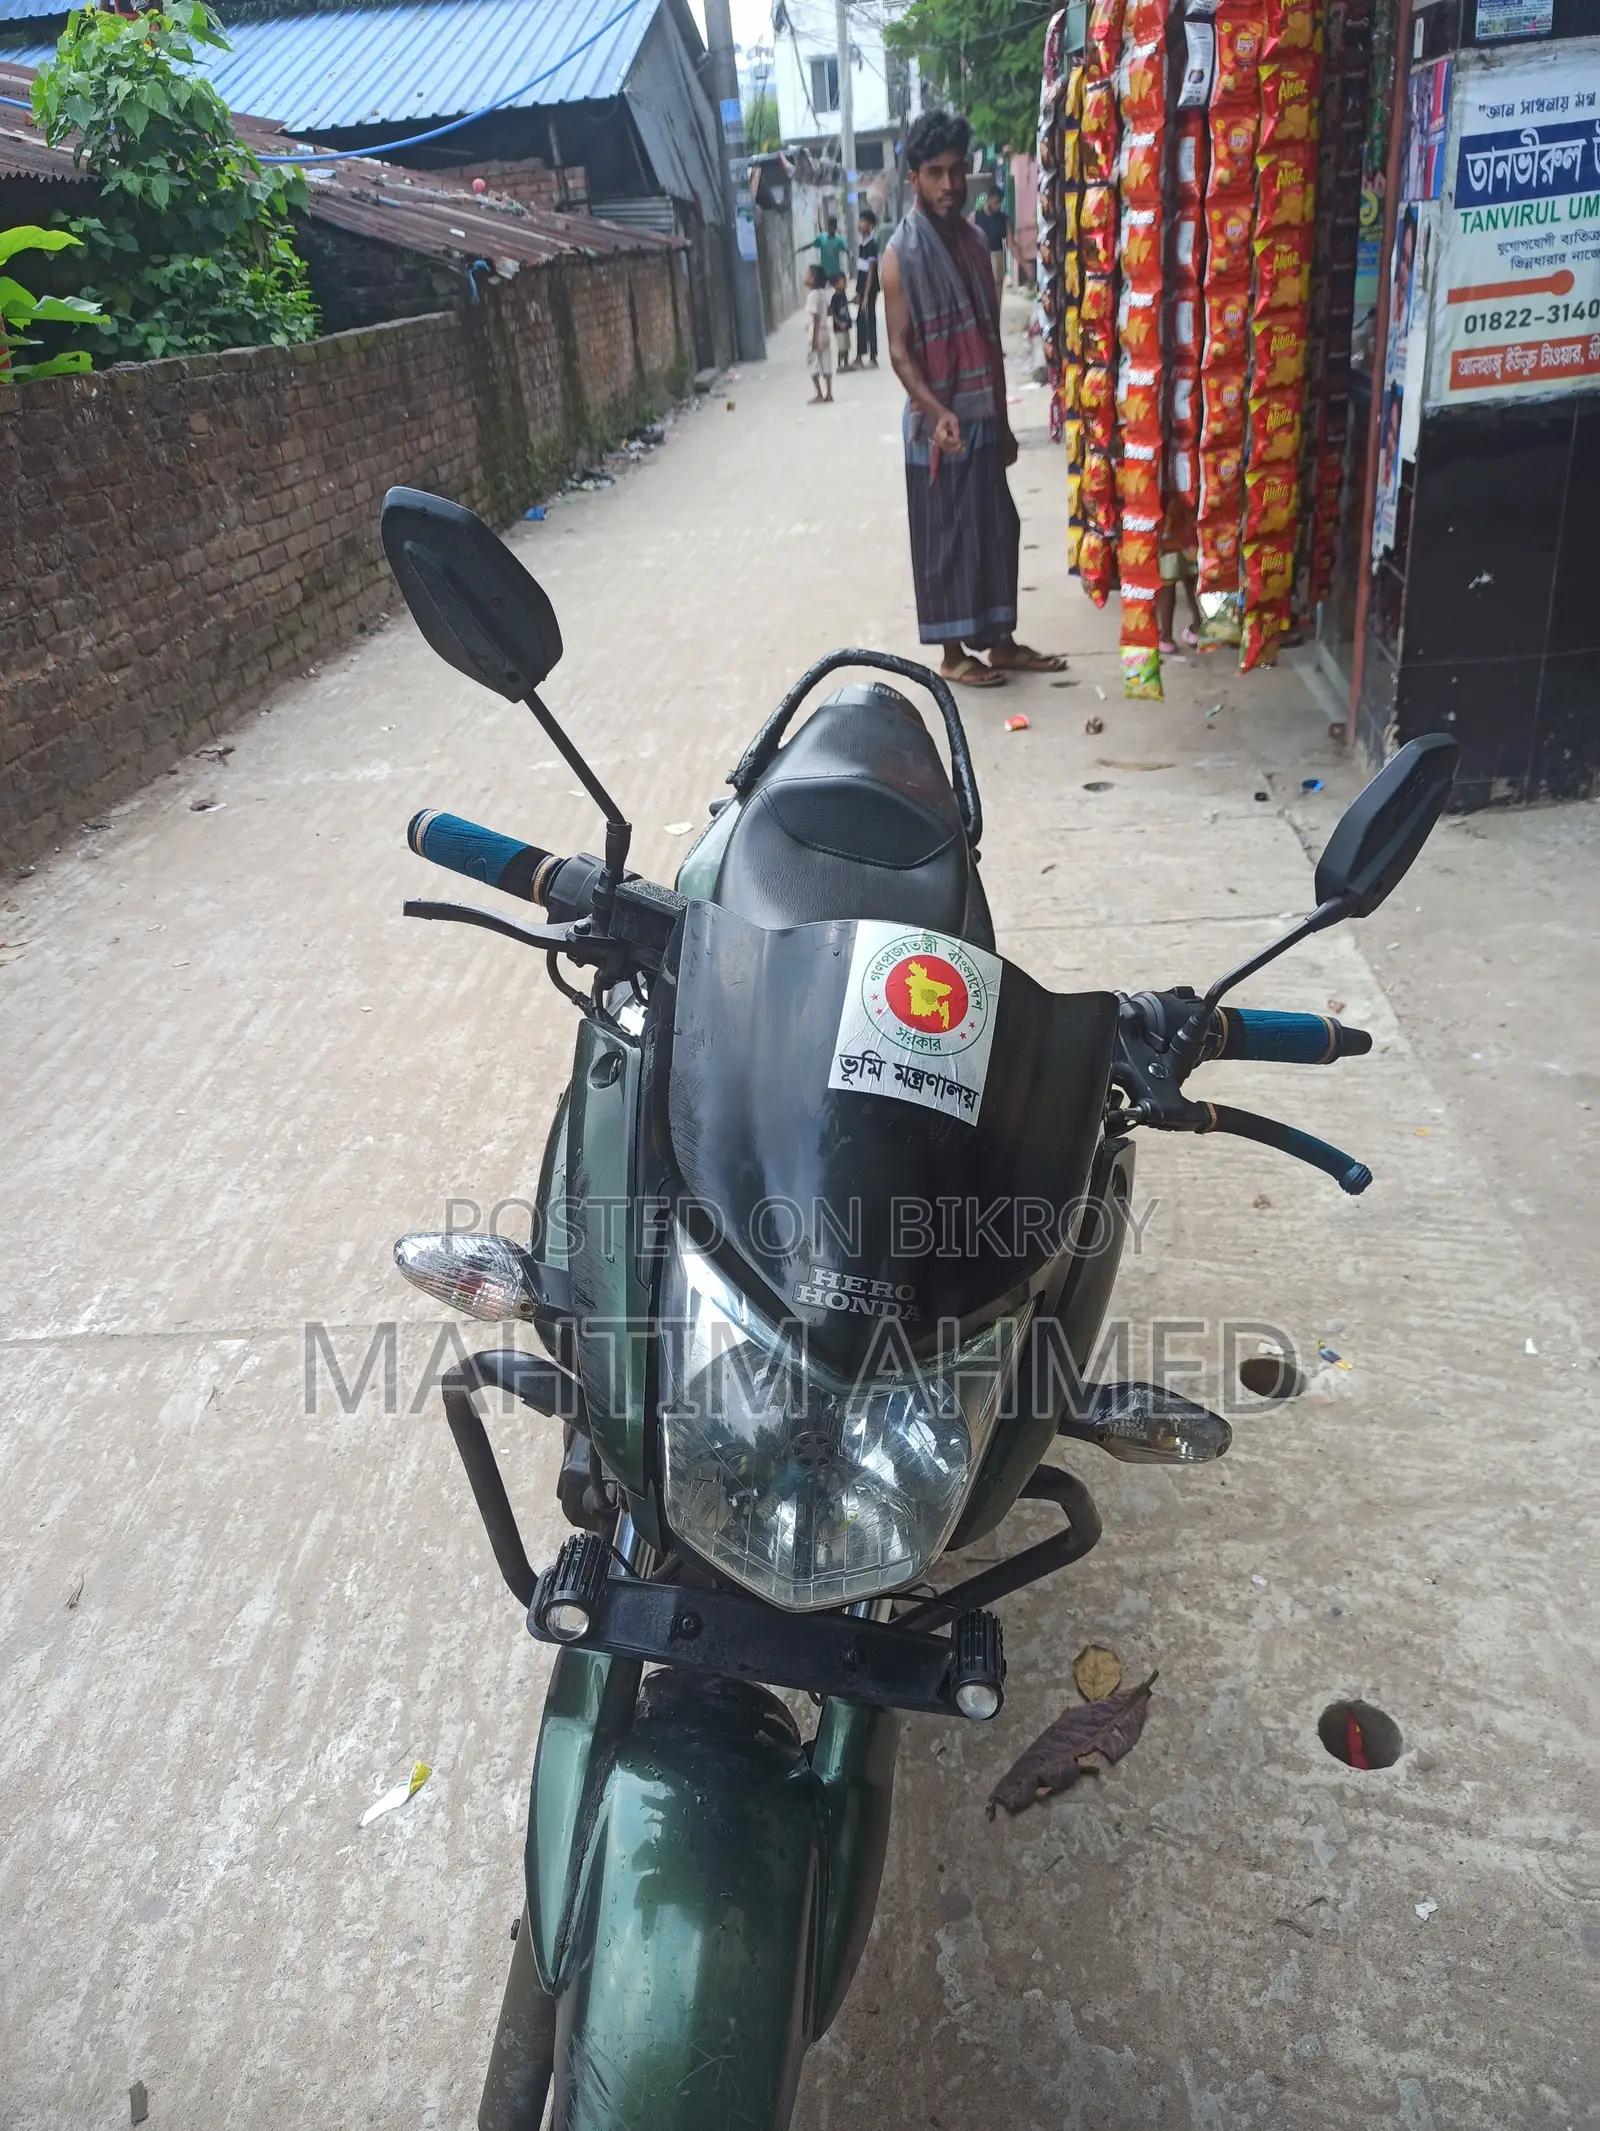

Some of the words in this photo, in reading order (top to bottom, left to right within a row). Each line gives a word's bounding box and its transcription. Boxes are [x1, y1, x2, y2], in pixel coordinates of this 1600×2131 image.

[1465, 126, 1587, 195] তানভীরুল
[1460, 200, 1561, 234] TANVIRUL
[1464, 298, 1600, 334] 01822-3140
[896, 1026, 941, 1051] সরকার
[839, 1050, 887, 1086] ভূমি
[893, 1062, 980, 1112] মন্ত্রণালয়
[796, 1284, 920, 1320] HONDA
[812, 1268, 916, 1301] HERO
